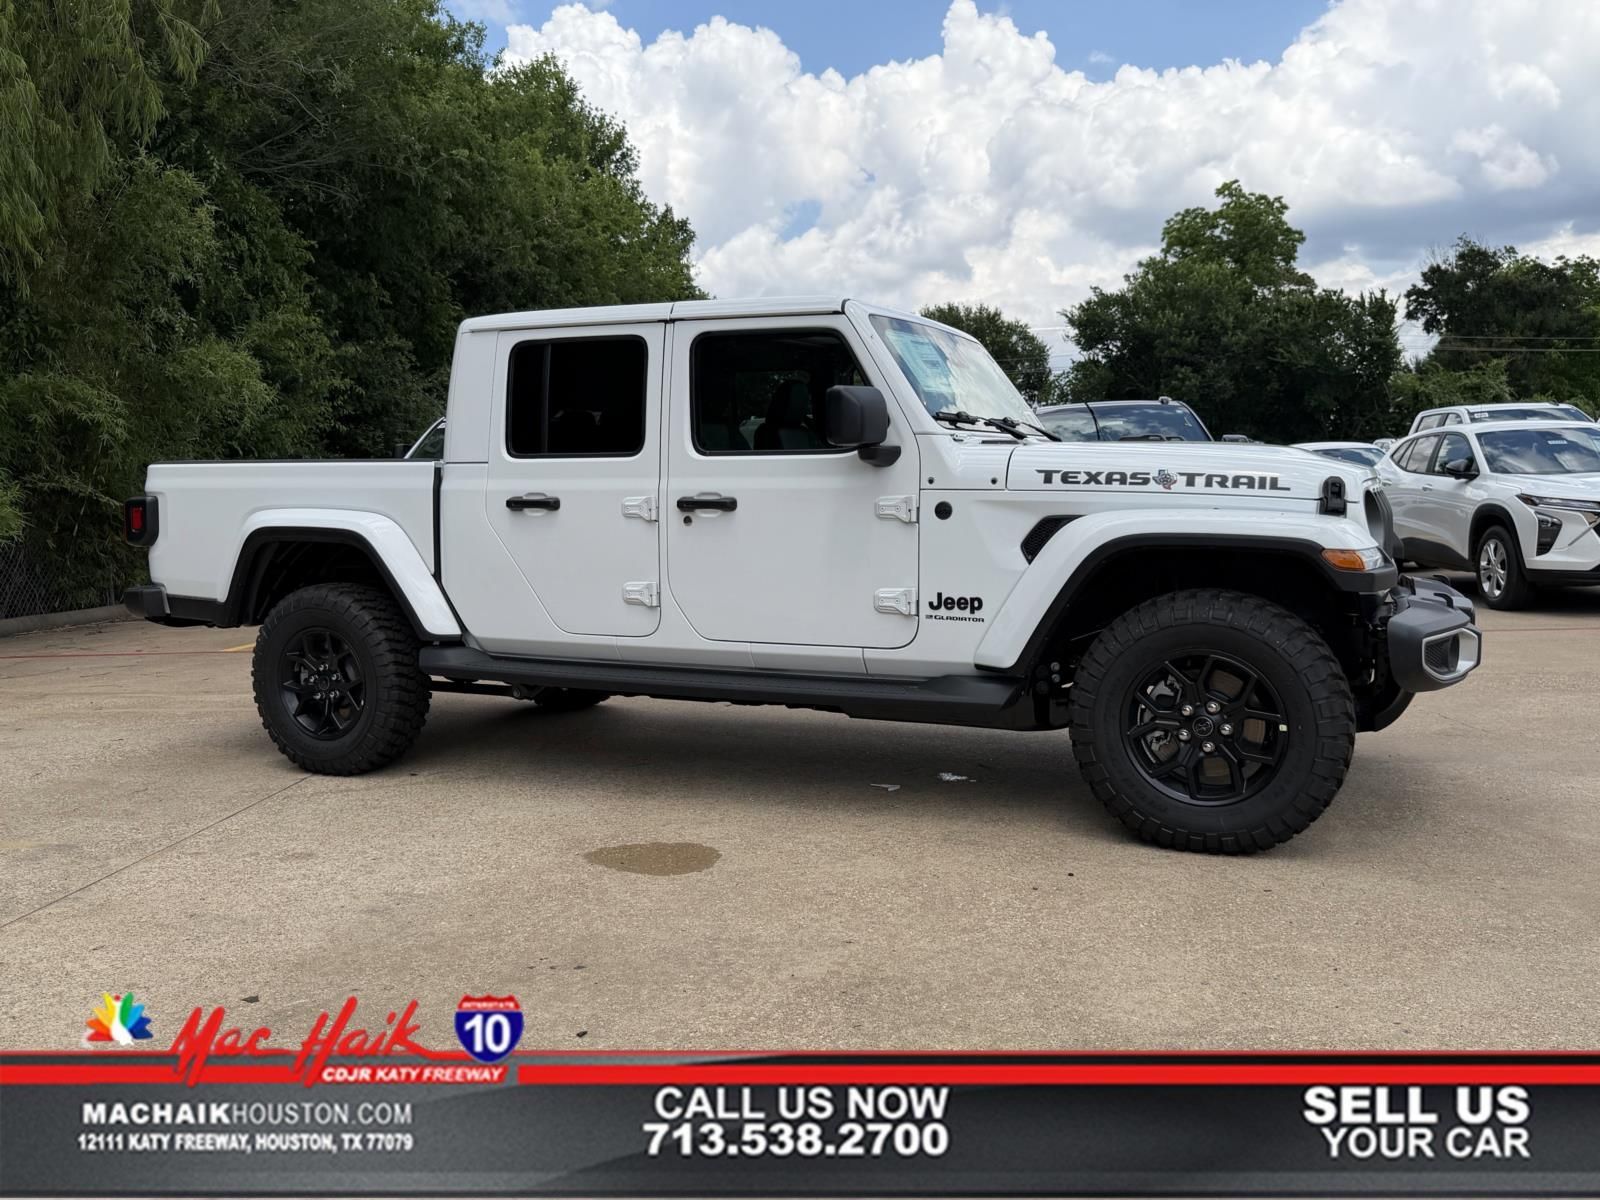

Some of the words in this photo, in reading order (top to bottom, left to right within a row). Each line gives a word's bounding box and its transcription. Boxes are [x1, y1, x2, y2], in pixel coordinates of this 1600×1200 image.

[1035, 469, 1150, 486] TEXAS
[1177, 472, 1291, 491] TRAIL
[928, 592, 983, 614] Jeep
